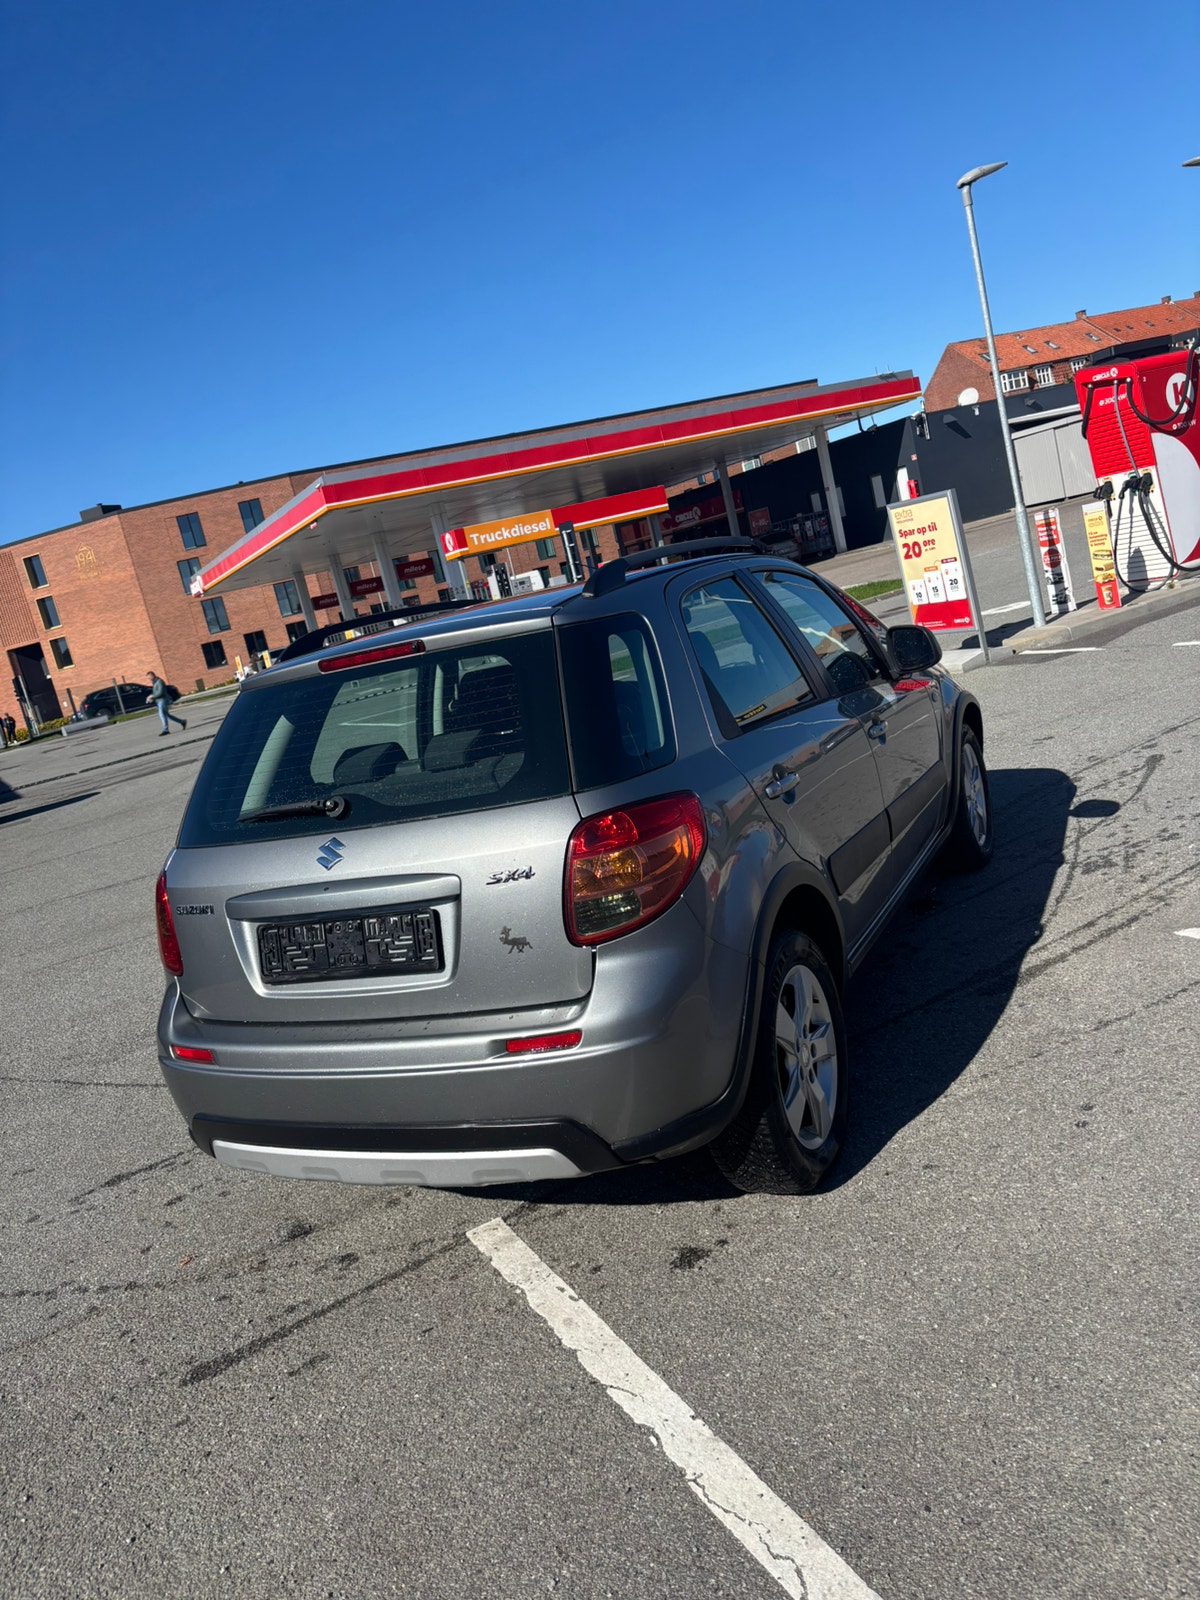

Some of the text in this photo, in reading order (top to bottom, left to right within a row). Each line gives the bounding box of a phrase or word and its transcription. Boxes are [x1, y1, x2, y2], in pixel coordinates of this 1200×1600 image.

[895, 509, 913, 520] extra
[469, 518, 551, 546] Truckdiesel
[898, 521, 938, 539] Spar op til
[902, 541, 923, 560] 20
[949, 578, 959, 586] 20
[485, 865, 537, 886] SX4
[176, 904, 216, 917] SUZUKI
